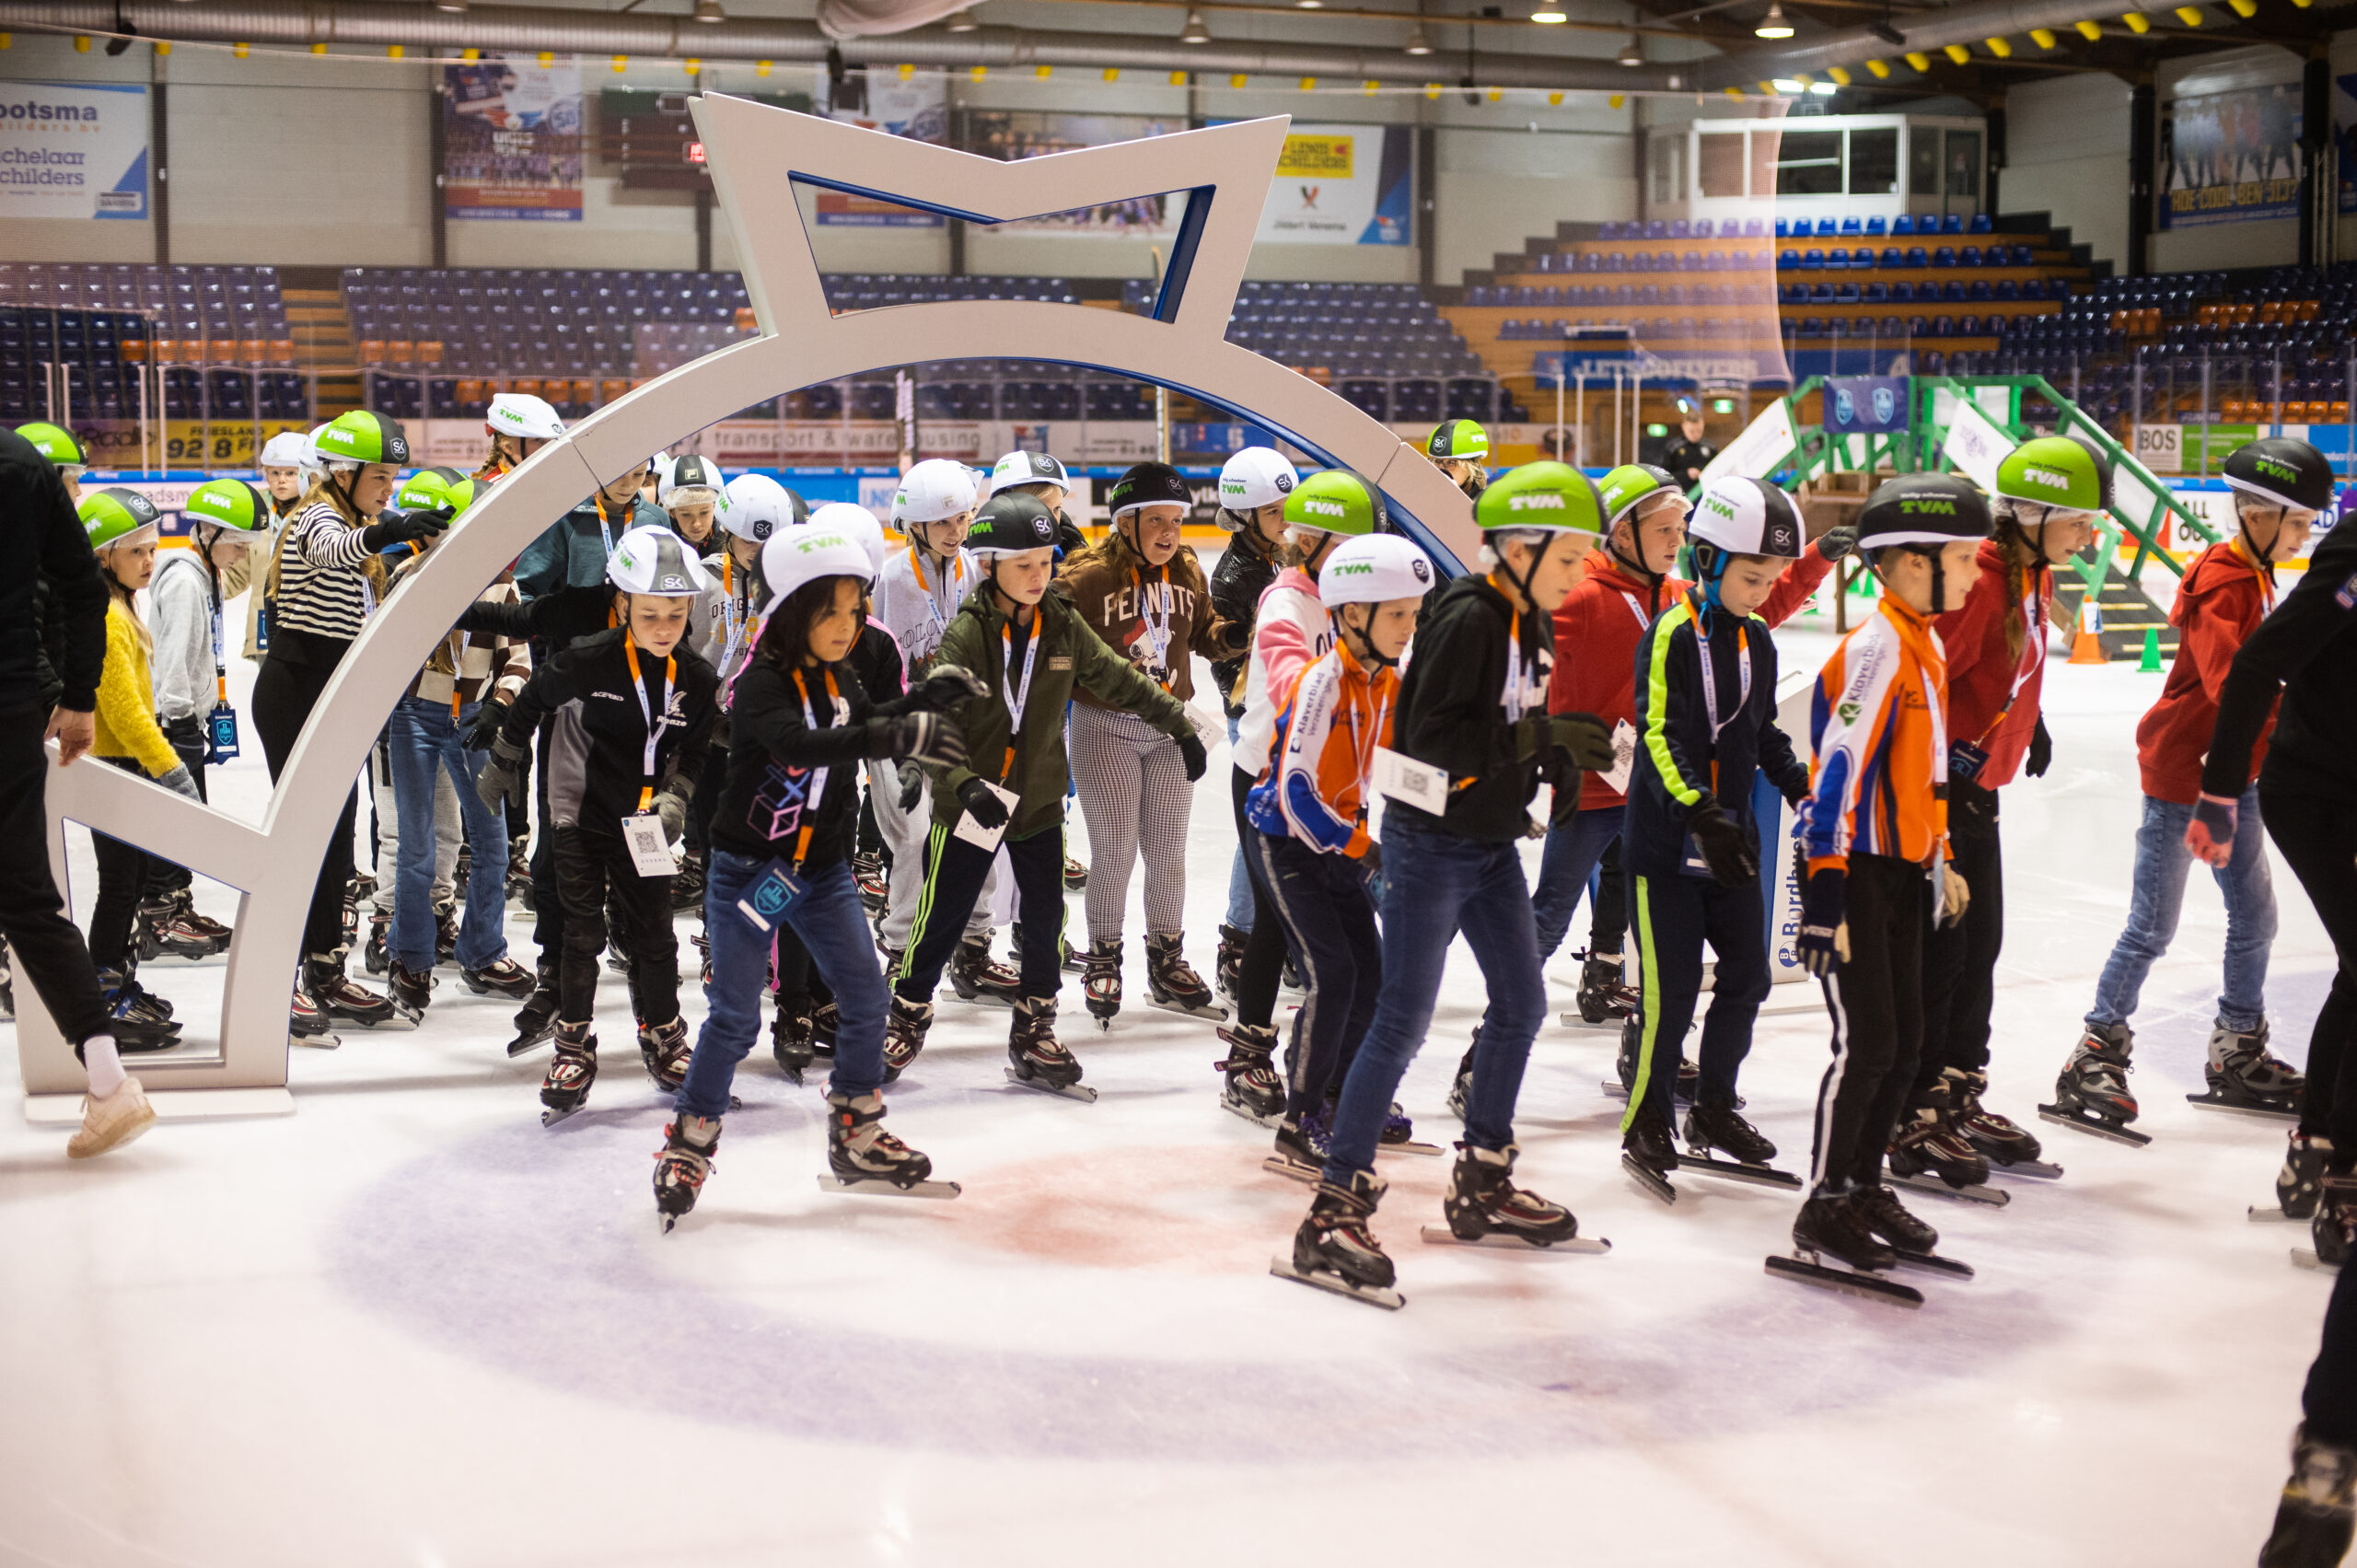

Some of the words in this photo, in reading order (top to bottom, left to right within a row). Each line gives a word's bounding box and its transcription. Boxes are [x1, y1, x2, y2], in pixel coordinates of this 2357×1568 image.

[499, 408, 523, 424] TVM
[327, 429, 354, 445] TVM
[714, 428, 822, 449] transport
[847, 427, 981, 449] wareusing
[2139, 429, 2177, 451] BOS
[2024, 468, 2069, 490] TVM
[2257, 461, 2296, 484] TVM
[1222, 483, 1247, 494] TVM
[203, 493, 232, 510] TVM
[405, 493, 432, 505] TVM
[1508, 494, 1566, 511] TVM
[1304, 500, 1344, 517] TVM
[1703, 498, 1735, 521] TVM
[1899, 500, 1957, 516] TVM
[2182, 500, 2209, 519] ALL
[756, 523, 770, 534] SK
[1036, 518, 1051, 532] SK
[1775, 529, 1791, 544] SK
[1333, 563, 1374, 576] TVM
[664, 576, 684, 588] SK
[1298, 672, 1326, 735] Klaverblad
